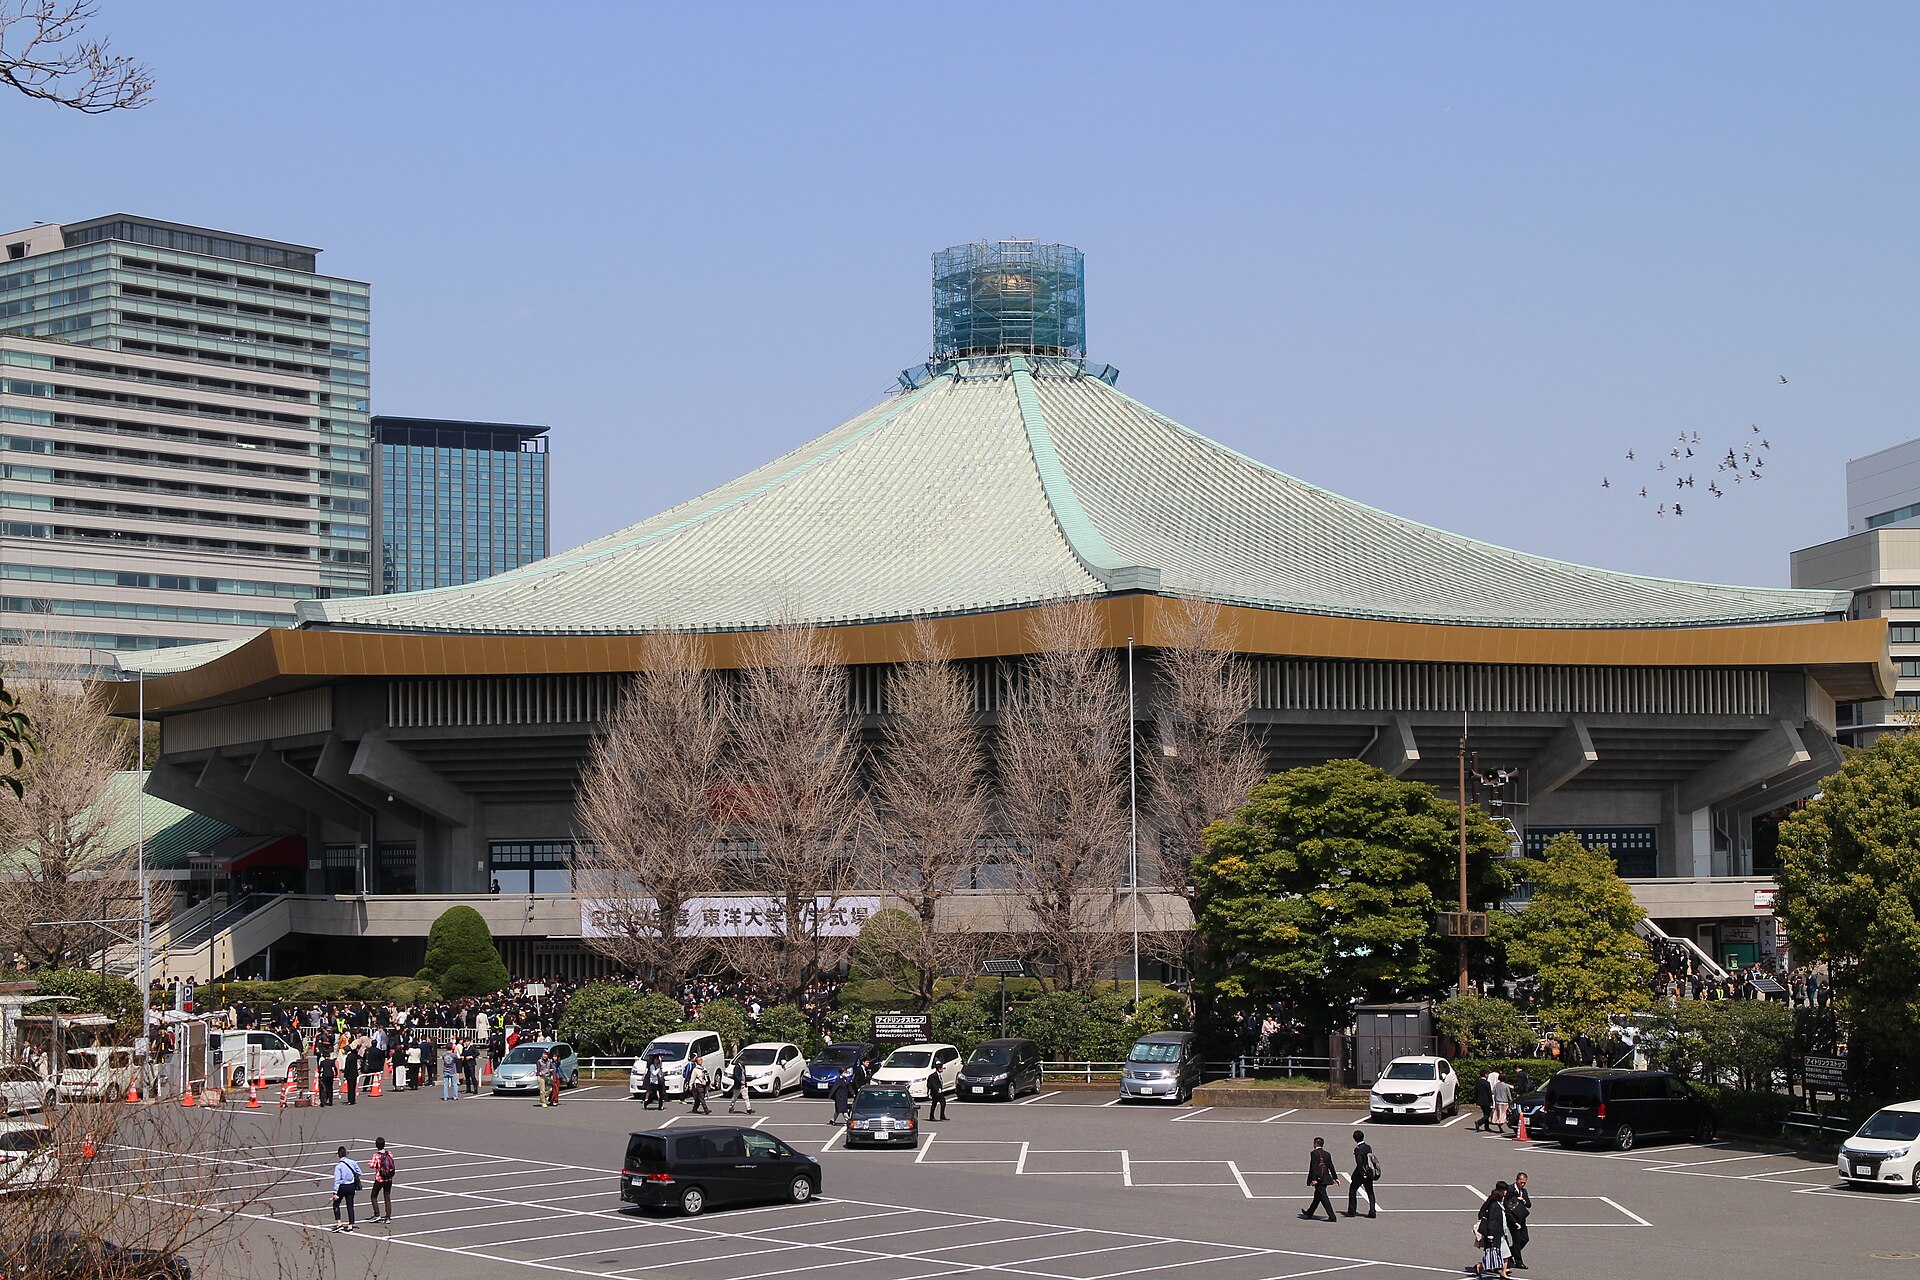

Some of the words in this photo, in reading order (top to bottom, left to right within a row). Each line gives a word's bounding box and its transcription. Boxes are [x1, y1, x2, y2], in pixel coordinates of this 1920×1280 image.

[701, 907, 869, 927] 東洋大学学式場
[184, 987, 192, 1001] P
